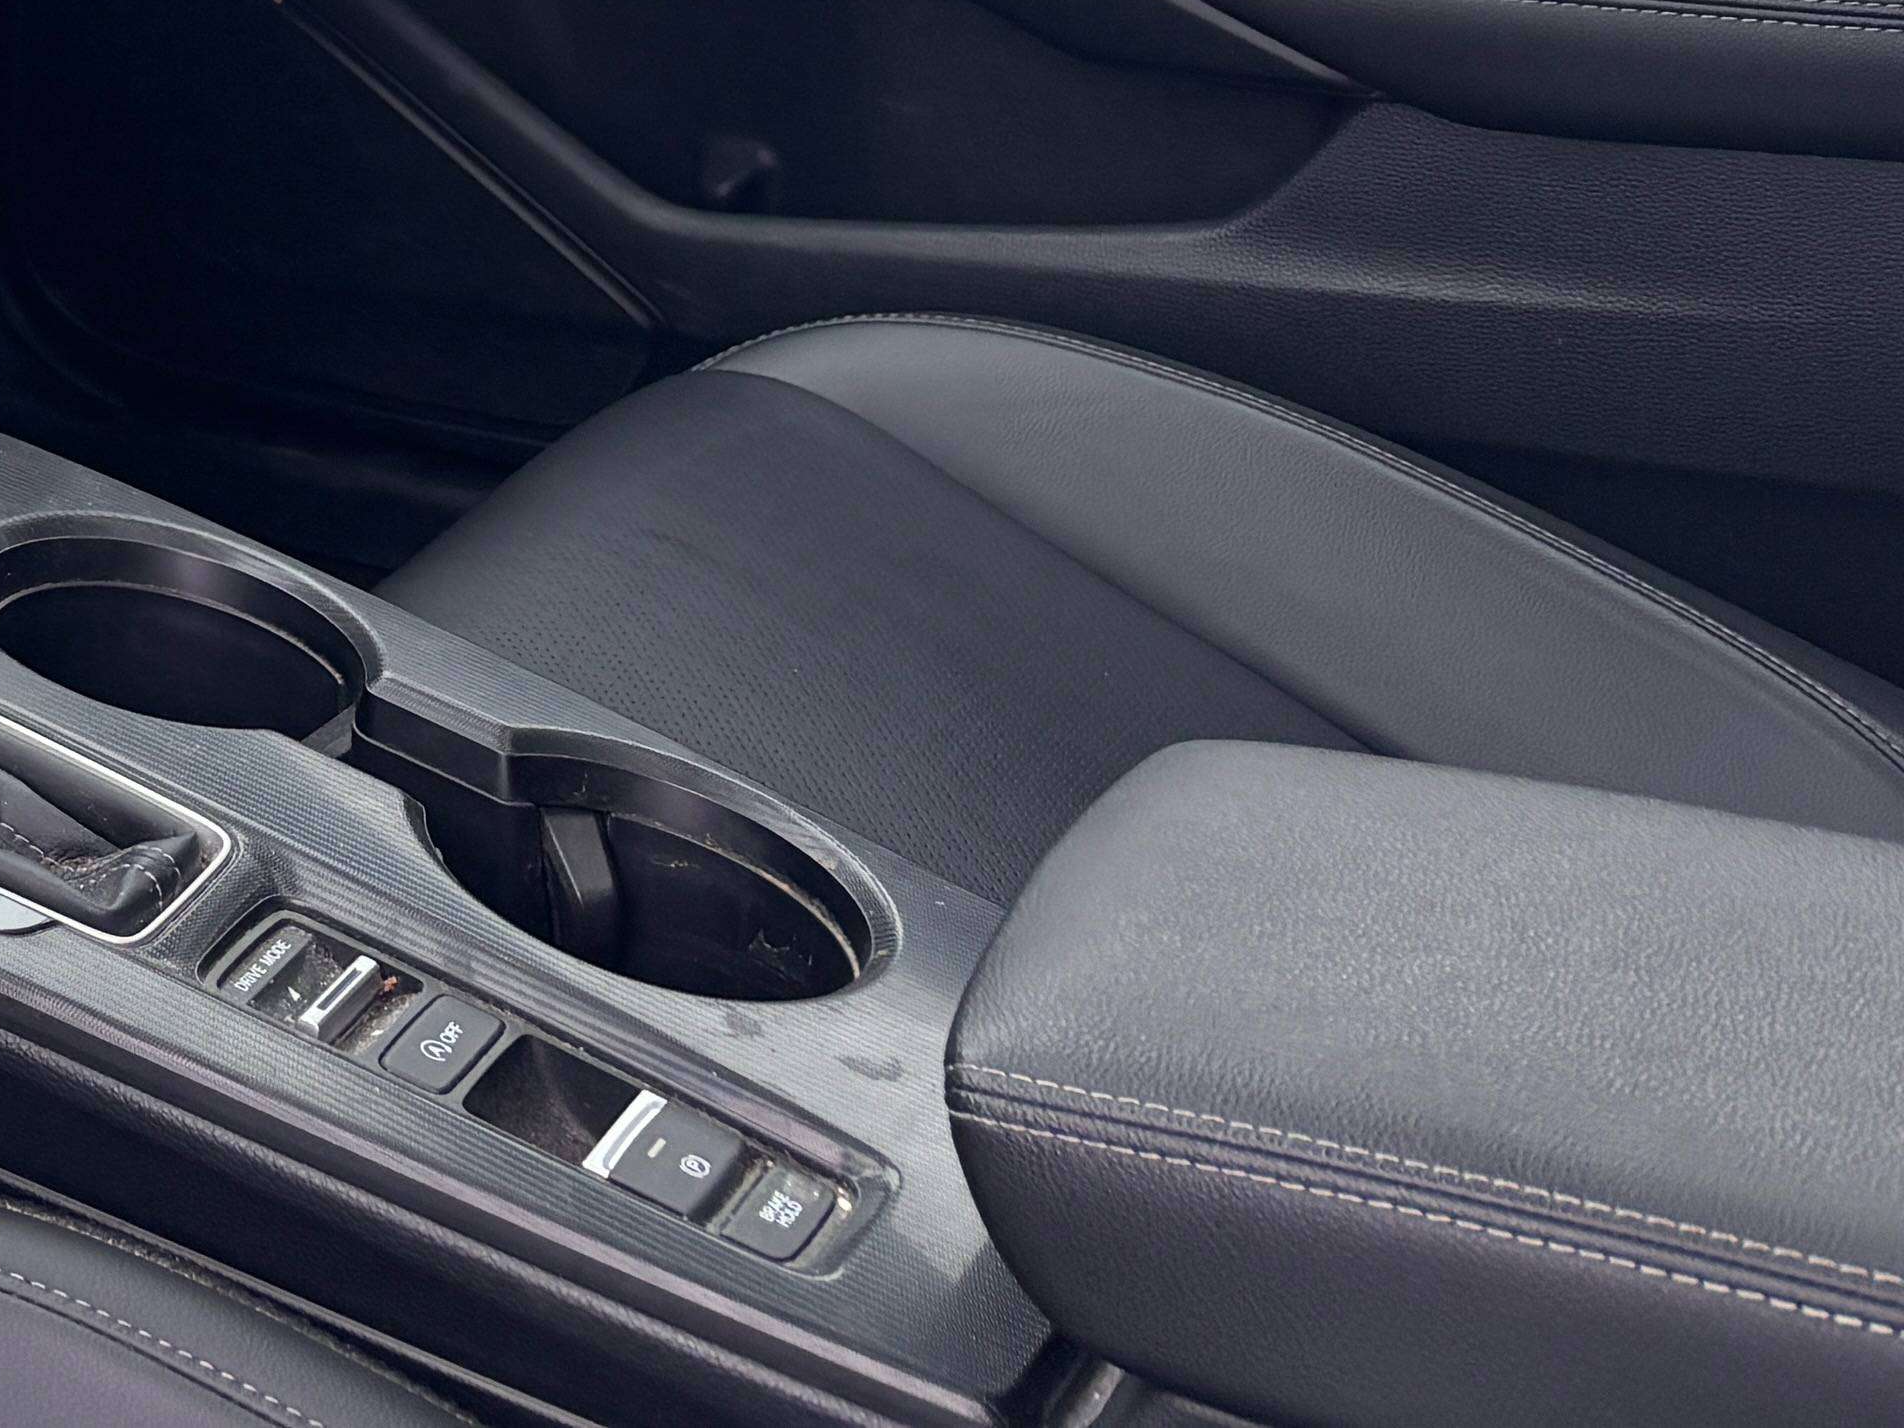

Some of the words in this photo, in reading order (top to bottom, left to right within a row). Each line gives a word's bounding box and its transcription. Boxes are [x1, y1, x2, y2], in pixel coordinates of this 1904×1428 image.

[234, 965, 269, 994] DRIVE
[260, 937, 293, 969] MODE
[439, 1020, 465, 1046] OFF
[758, 1189, 790, 1224] BRAKE
[775, 1199, 804, 1229] HOLD
